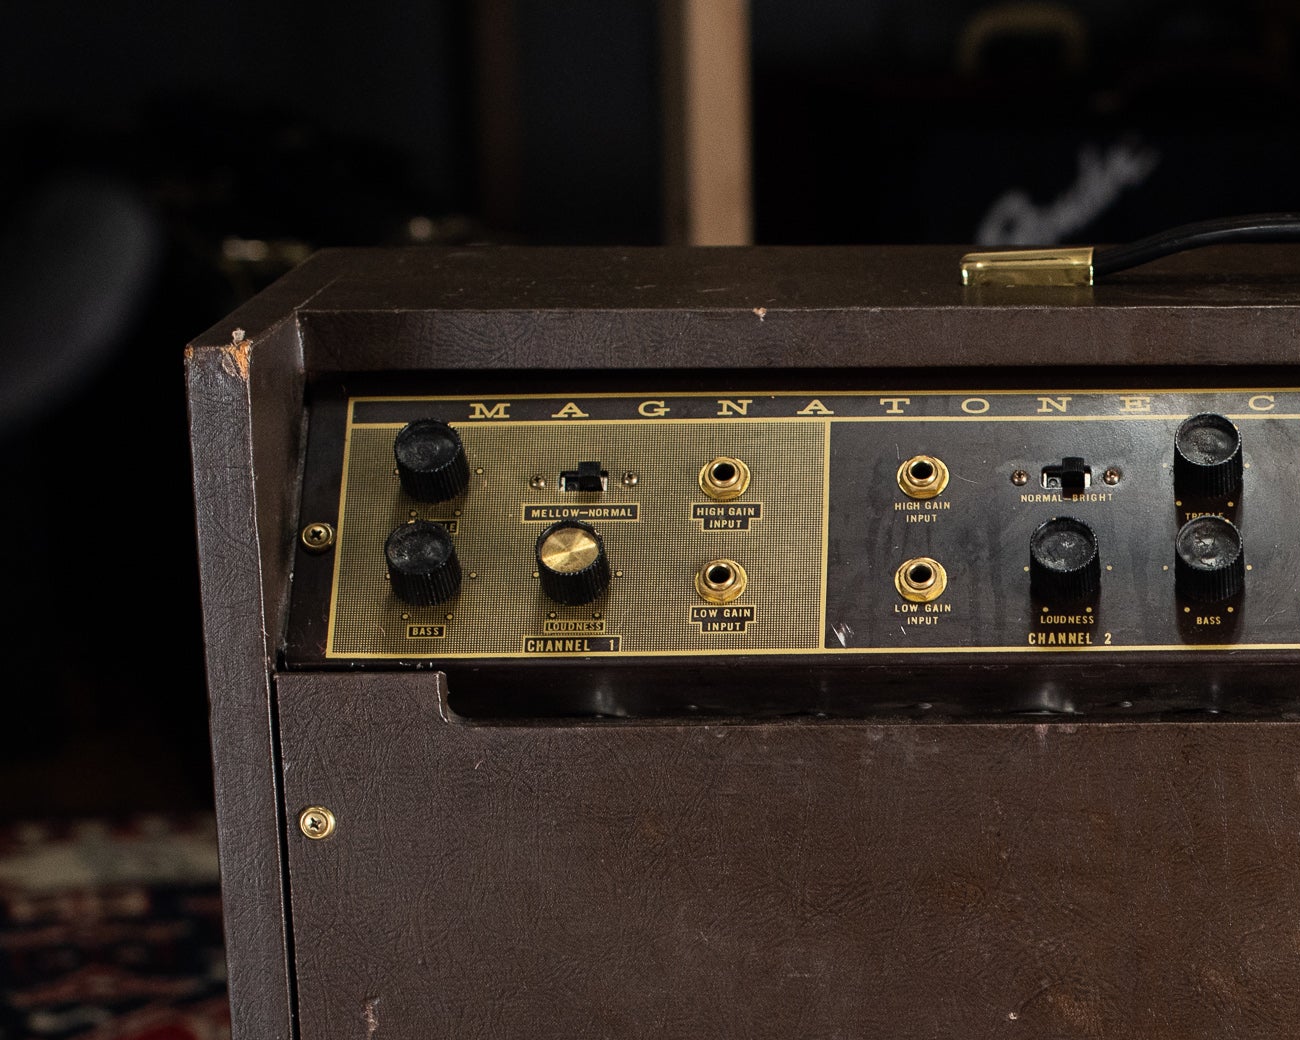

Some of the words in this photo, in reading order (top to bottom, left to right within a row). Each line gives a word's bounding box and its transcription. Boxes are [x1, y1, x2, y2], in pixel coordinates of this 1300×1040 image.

[894, 502, 920, 511] HIGH
[925, 501, 951, 511] GAIN
[697, 506, 723, 517] HIGH
[729, 506, 756, 516] GAIN
[906, 514, 938, 523] INPUT
[709, 519, 743, 529] INPUT
[693, 608, 718, 618] LOW
[724, 608, 751, 617] GAIN
[895, 603, 920, 613] LOW
[925, 603, 952, 613] GAIN
[907, 616, 939, 625] INPUT
[1040, 614, 1094, 624] LOUDNESS
[1196, 616, 1221, 625] BASS
[412, 625, 440, 636] BASS
[547, 621, 601, 631] LOUDNESS
[707, 621, 741, 631] INPUT
[1028, 632, 1092, 645] CHANNEL
[1105, 632, 1112, 644] 2
[527, 639, 590, 652] CHANNEL
[609, 639, 615, 651] 1
